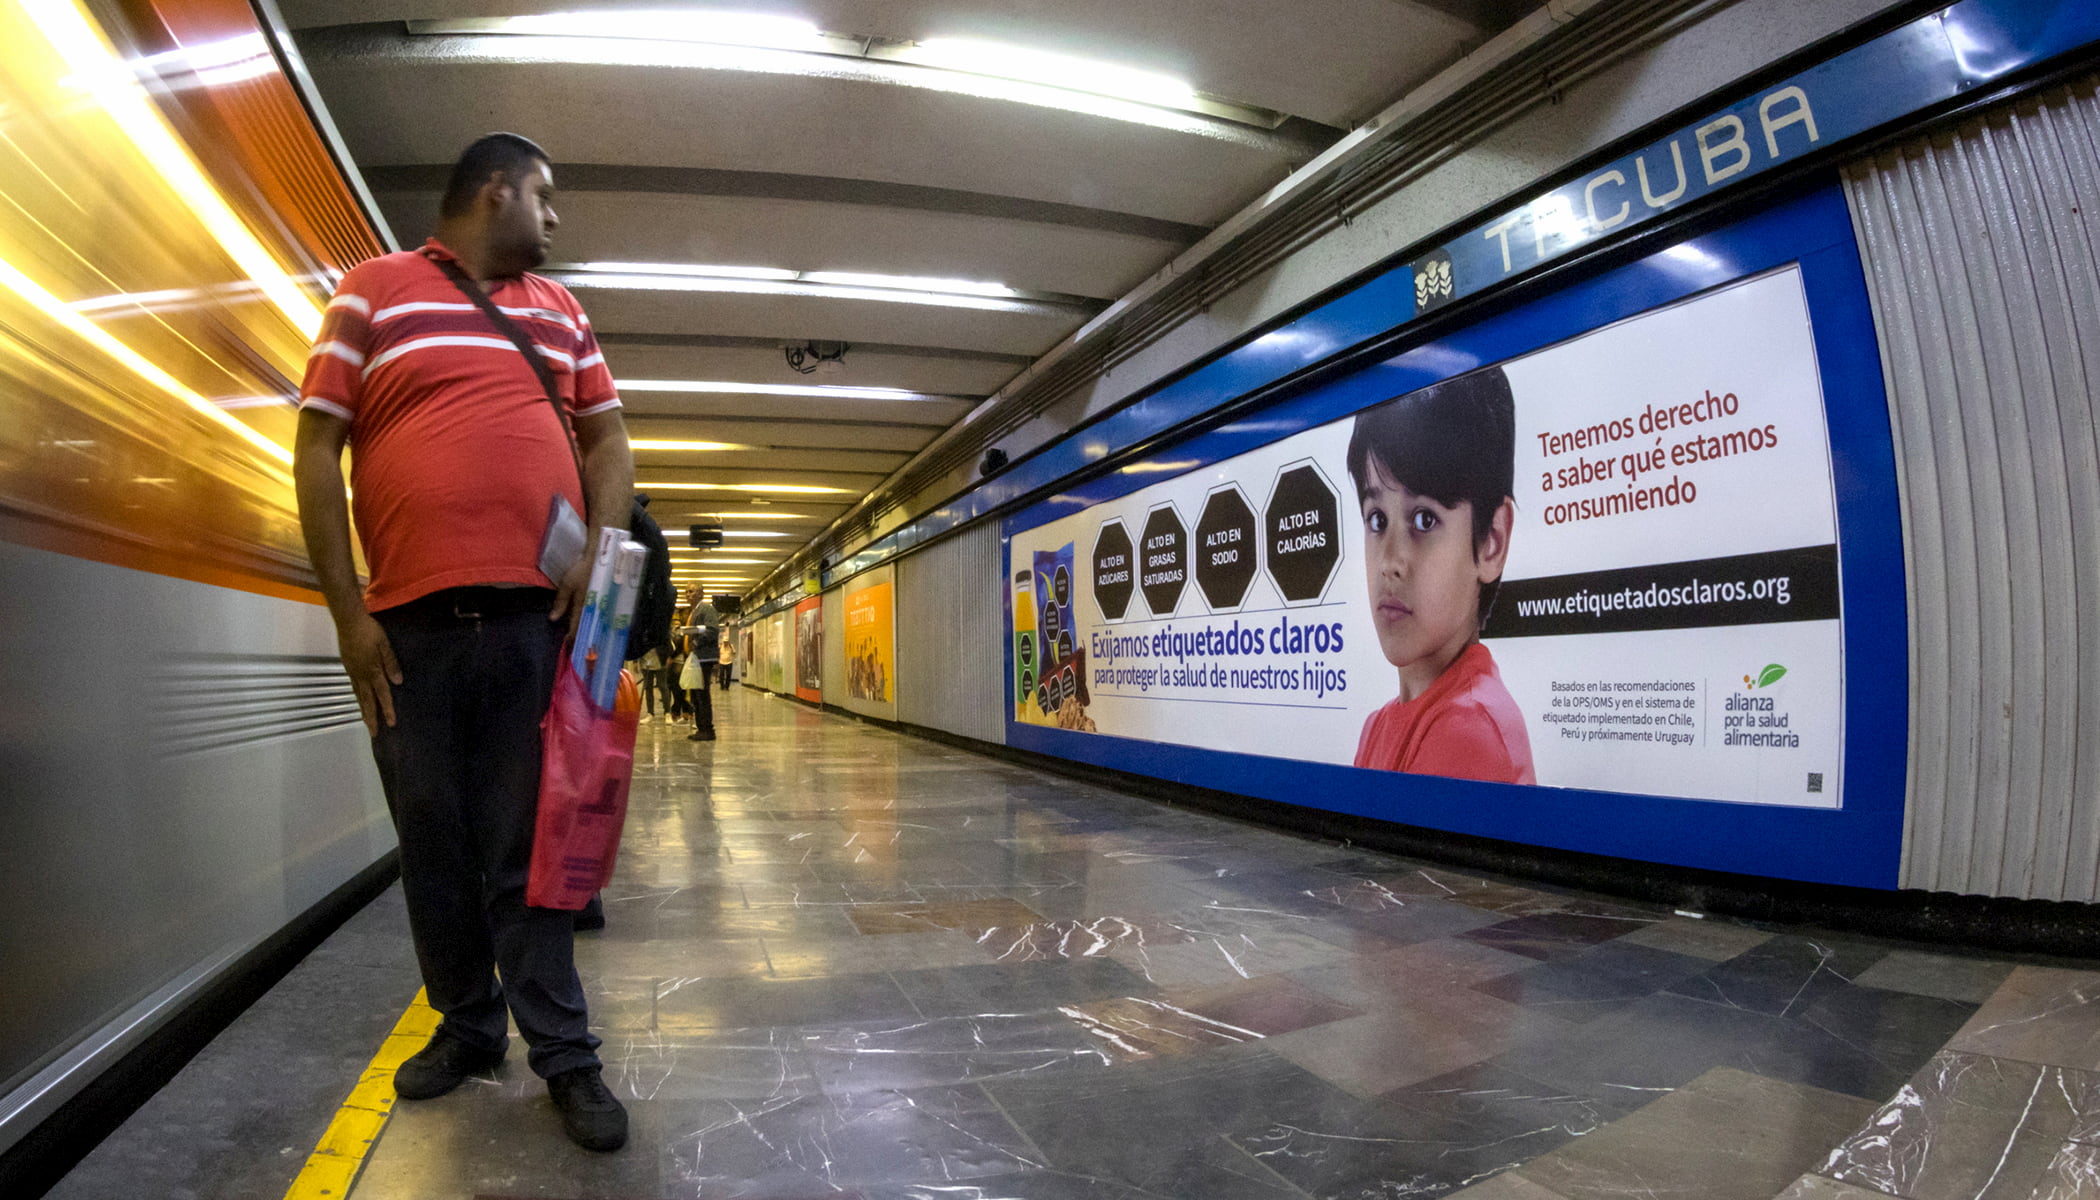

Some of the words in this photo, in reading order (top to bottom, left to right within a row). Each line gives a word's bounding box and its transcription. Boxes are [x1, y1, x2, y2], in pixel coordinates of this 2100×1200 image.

[1484, 85, 1819, 273] TACUBA
[1537, 416, 1635, 457] Tenemos
[1639, 389, 1739, 435] derecho
[1542, 471, 1553, 492] a
[1557, 456, 1617, 489] saber
[1621, 436, 1666, 482] qué
[1671, 424, 1778, 466] estamos
[1544, 475, 1697, 526] consumiendo
[1278, 513, 1304, 532] ALTO
[1305, 509, 1319, 526] EN
[1147, 535, 1165, 551] ALTO
[1165, 533, 1175, 546] EN
[1206, 530, 1228, 547] ALTO
[1229, 527, 1242, 541] EN
[1277, 531, 1327, 554] CALORÍAS
[1100, 555, 1116, 569] ALTO
[1116, 554, 1125, 566] EN
[1148, 551, 1176, 568] GRASAS
[1211, 549, 1239, 566] SODIO
[1098, 570, 1129, 586] AZÚCARES
[1143, 568, 1183, 587] SATURADAS
[1517, 576, 1791, 618] www.etiquetadosclaros.org
[1092, 630, 1149, 666] Exijamos
[1152, 619, 1265, 664] etiquetados
[1269, 615, 1344, 655] claros
[1094, 667, 1115, 689] para
[1116, 664, 1158, 692] proteger
[1160, 663, 1170, 687] la
[1173, 662, 1206, 688] salud
[1210, 662, 1227, 689] de
[1231, 664, 1299, 690] nuestros
[1303, 661, 1347, 699] hijos
[1551, 680, 1586, 692] Basados
[1586, 683, 1598, 692] en
[1599, 680, 1612, 692] las
[1613, 680, 1696, 692] recomendaciones
[1552, 696, 1563, 708] de
[1563, 696, 1571, 708] la
[1572, 696, 1614, 709] OPS/OMS
[1615, 699, 1621, 711] y
[1622, 699, 1634, 709] en
[1635, 697, 1644, 709] el
[1645, 697, 1681, 709] sistema
[1682, 697, 1696, 709] de
[1725, 692, 1774, 712] alianza
[1542, 712, 1586, 725] etiquetado
[1588, 712, 1653, 726] implementado
[1654, 716, 1666, 726] en
[1668, 713, 1695, 728] Chile,
[1724, 715, 1744, 730] por
[1746, 712, 1755, 728] la
[1758, 712, 1789, 728] salud
[1561, 728, 1580, 739] Perú
[1581, 730, 1587, 742] y
[1588, 728, 1653, 742] próximamente
[1654, 733, 1695, 746] Uruguay
[1723, 728, 1800, 748] alimentaria
